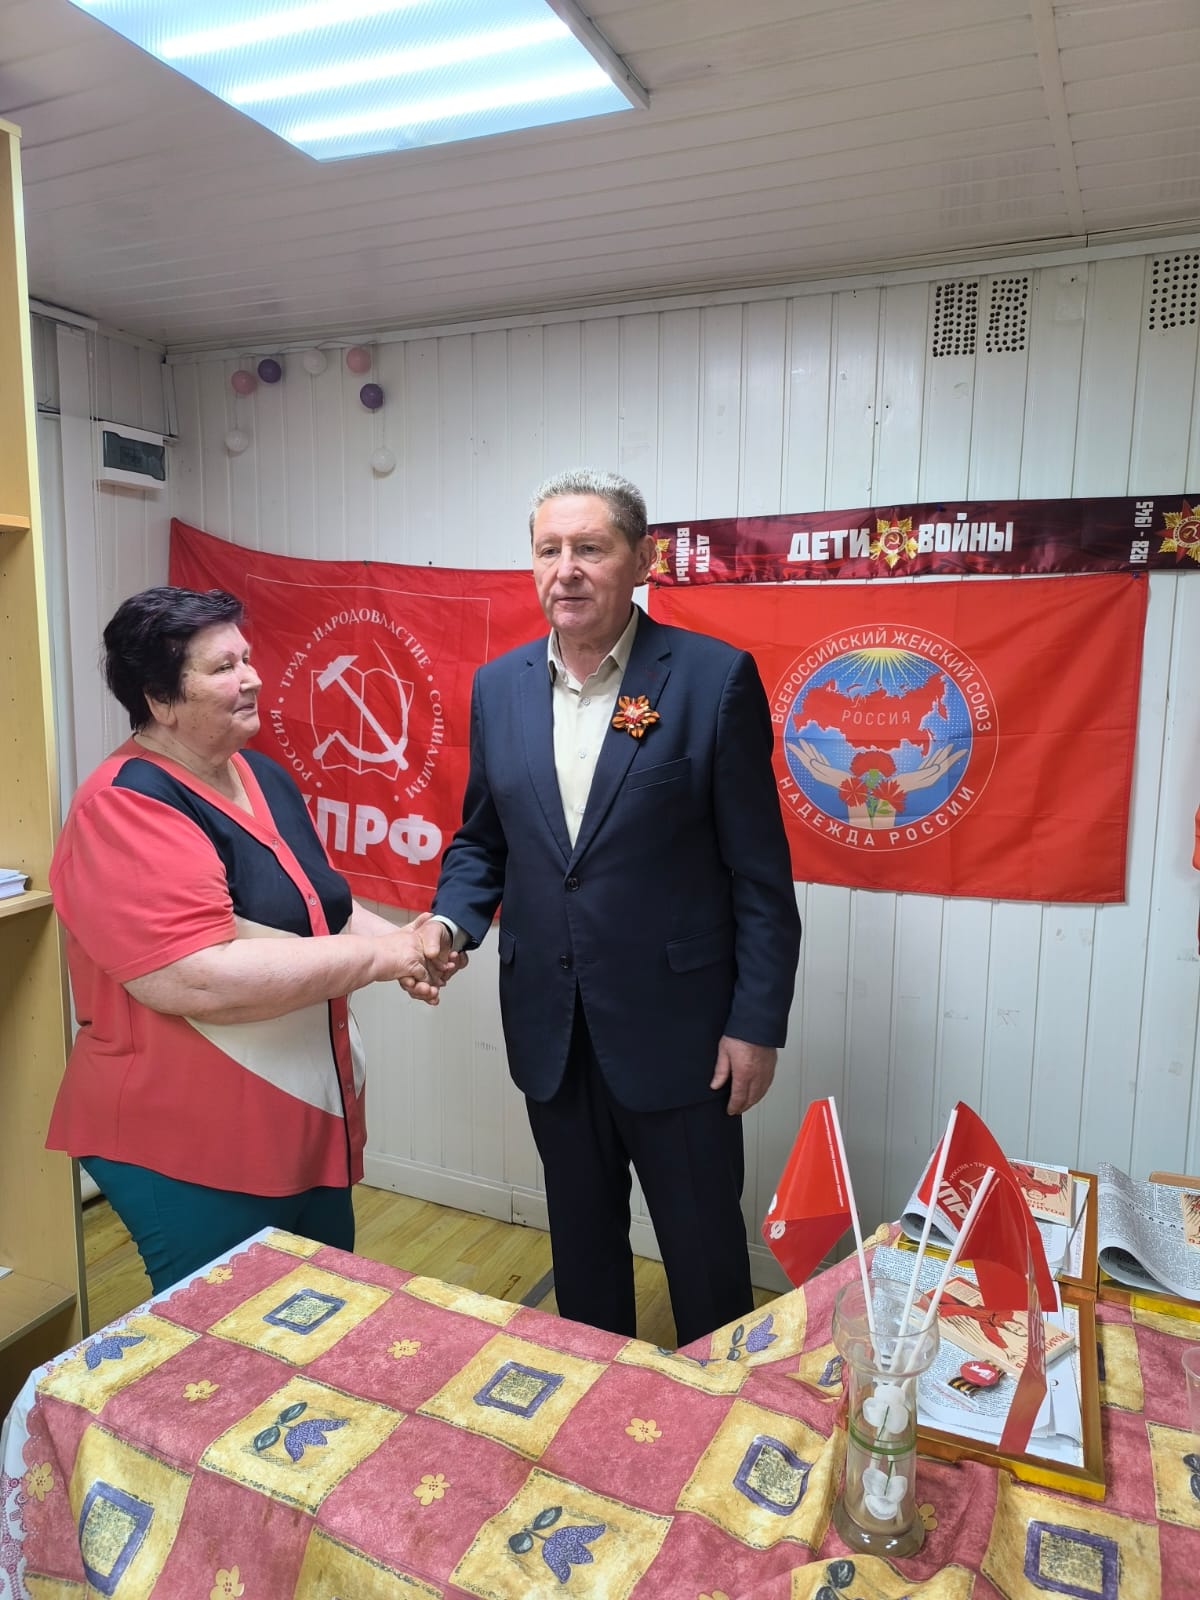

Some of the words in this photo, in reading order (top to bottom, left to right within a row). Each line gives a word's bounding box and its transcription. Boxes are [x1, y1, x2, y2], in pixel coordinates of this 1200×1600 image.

[787, 528, 870, 562] ДЕТИ
[918, 512, 1014, 554] ВОЙНЫ
[1134, 501, 1154, 528] 1945
[675, 527, 694, 582] ВОЙНЫ
[695, 534, 710, 573] ДЕТИ
[1129, 540, 1150, 564] 1928
[311, 607, 432, 670] НАРОДОВЛАСТИЕ
[279, 650, 308, 689] ТРУД
[771, 626, 888, 725] ВСЕРОССИЙСКИЙ
[891, 630, 976, 683] ЖЕНСКИЙ
[965, 681, 992, 732] СОЮЗ
[841, 709, 912, 725] РОССИЯ
[270, 708, 314, 783] РОССИЯ
[404, 689, 445, 801] СОЦИАЛИЗМ
[302, 793, 443, 866] ПРФ
[779, 776, 875, 847] НАДЕЖДА
[889, 786, 974, 846] РОССИИ
